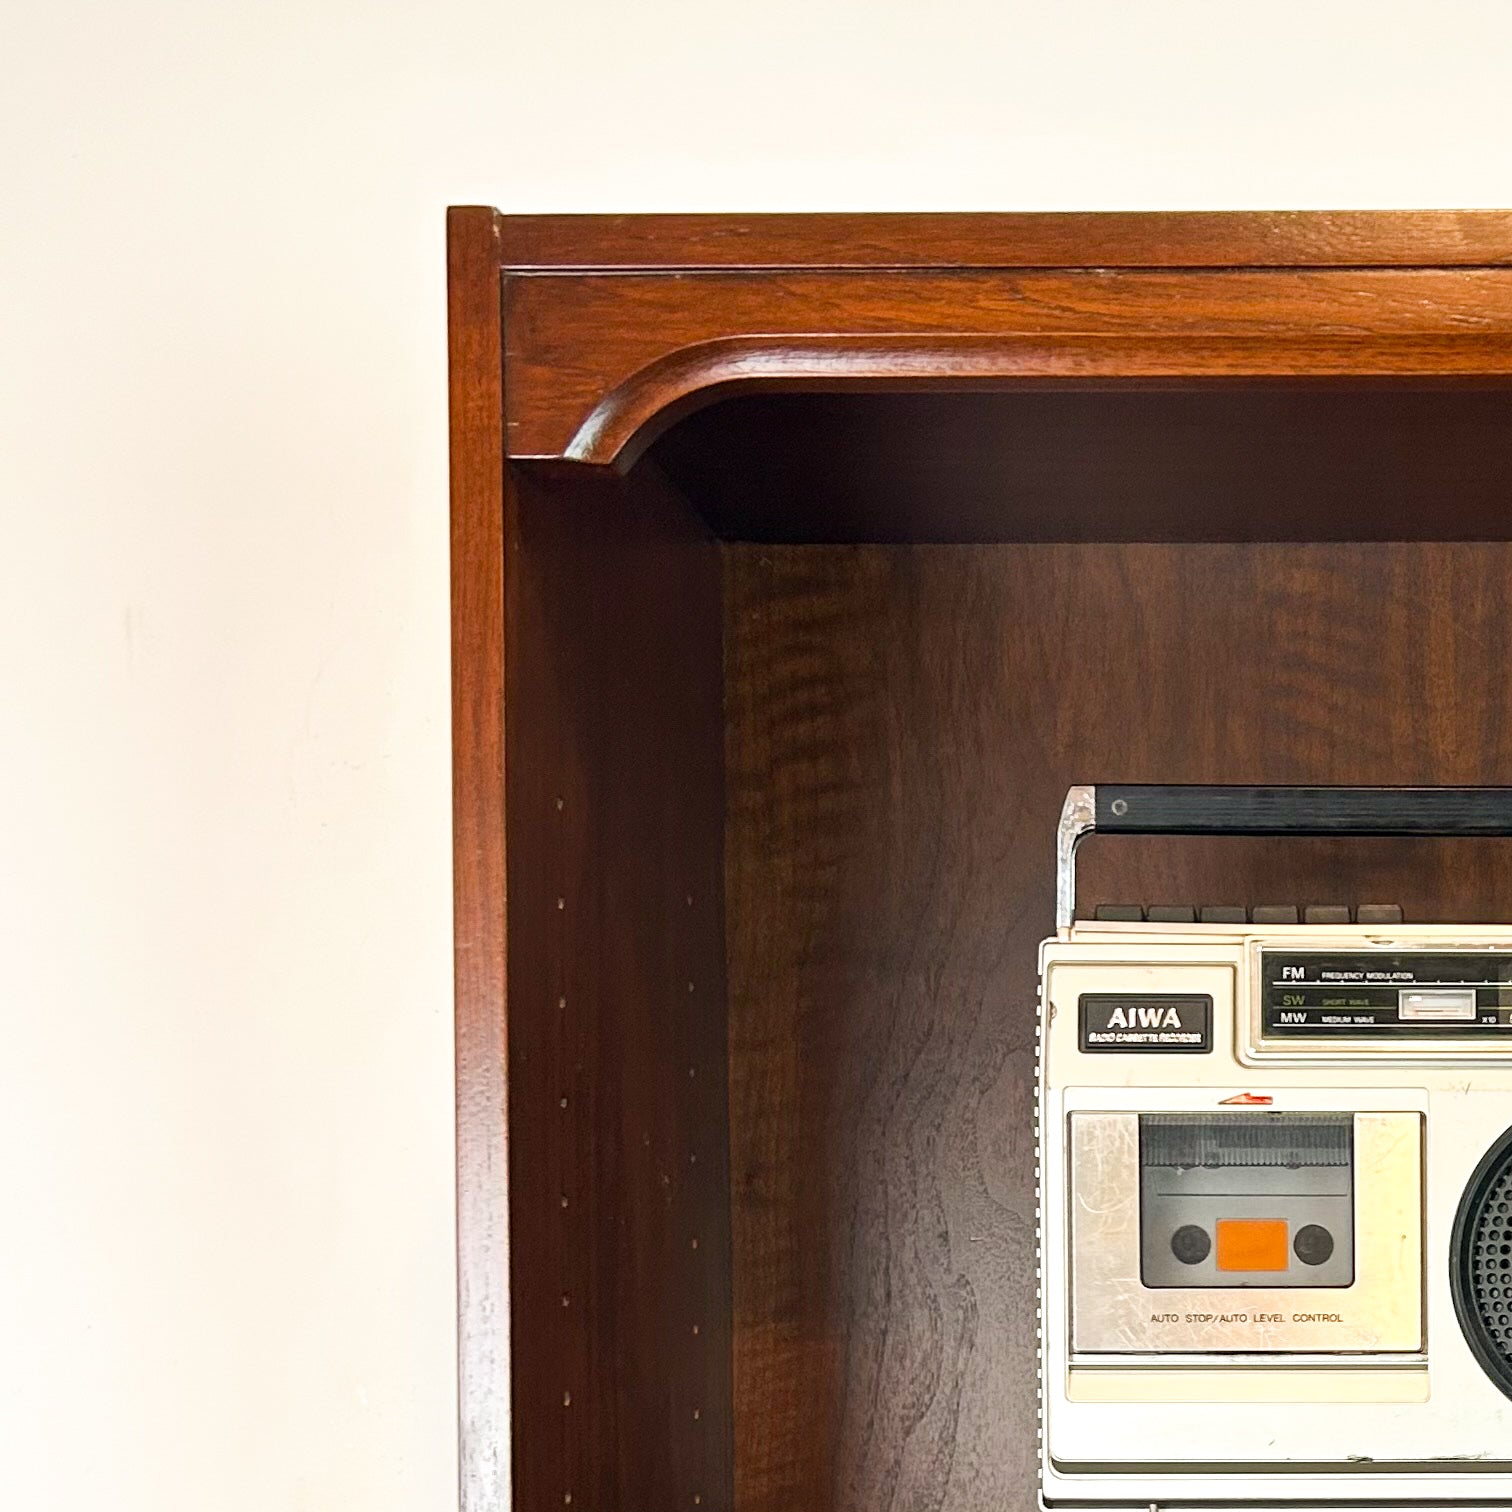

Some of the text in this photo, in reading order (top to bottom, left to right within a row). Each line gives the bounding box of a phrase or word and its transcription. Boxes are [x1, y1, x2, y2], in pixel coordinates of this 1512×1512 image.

[1282, 966, 1414, 980] FM FREQUENCY MODULATION
[1282, 994, 1305, 1006] SW
[1106, 1007, 1182, 1029] AIWA
[1280, 1012, 1307, 1024] MW
[1150, 1313, 1180, 1323] AUTO
[1253, 1313, 1286, 1323] LEVEL
[1292, 1313, 1344, 1323] CONTROL
